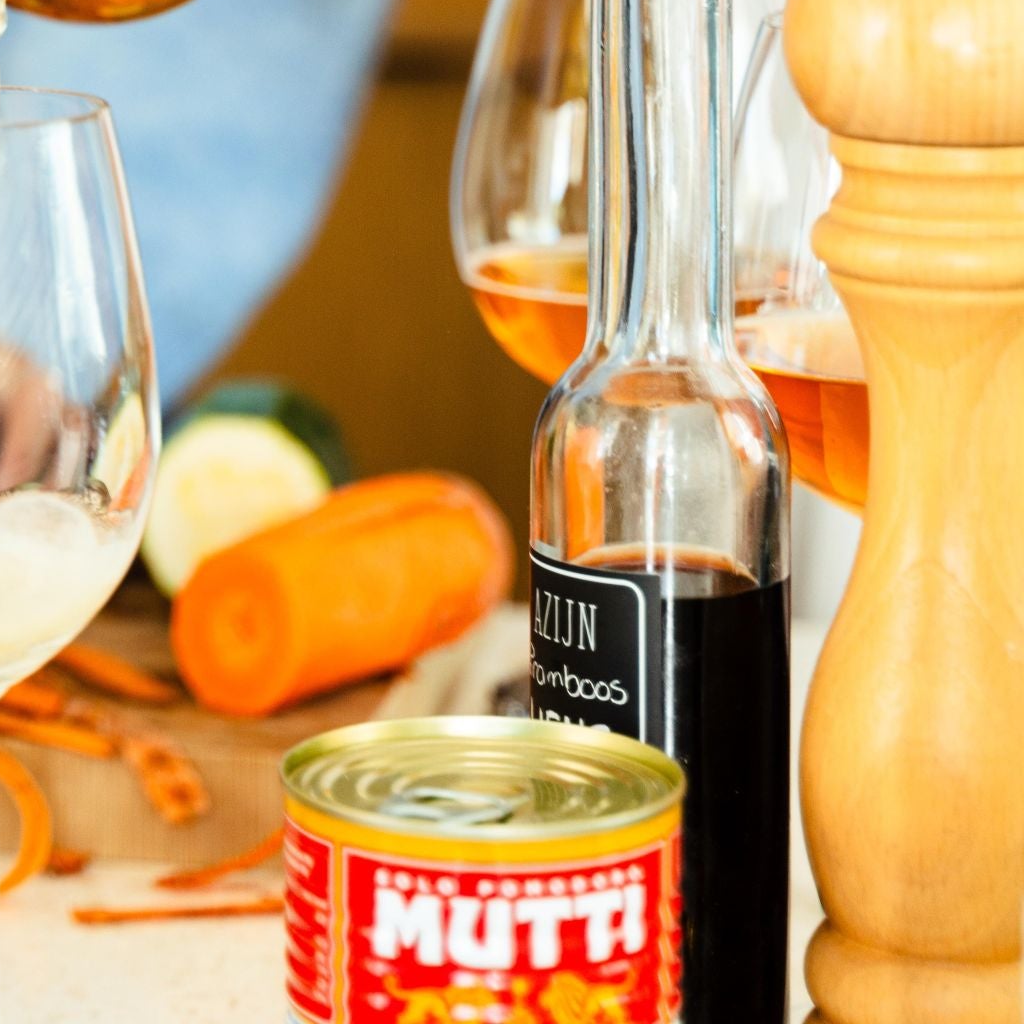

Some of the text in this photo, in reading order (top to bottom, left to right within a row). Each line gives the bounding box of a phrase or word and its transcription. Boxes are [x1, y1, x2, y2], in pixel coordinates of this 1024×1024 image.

[533, 587, 598, 652] AZIJN
[530, 642, 629, 706] ramboos
[371, 883, 647, 970] MUTTI
